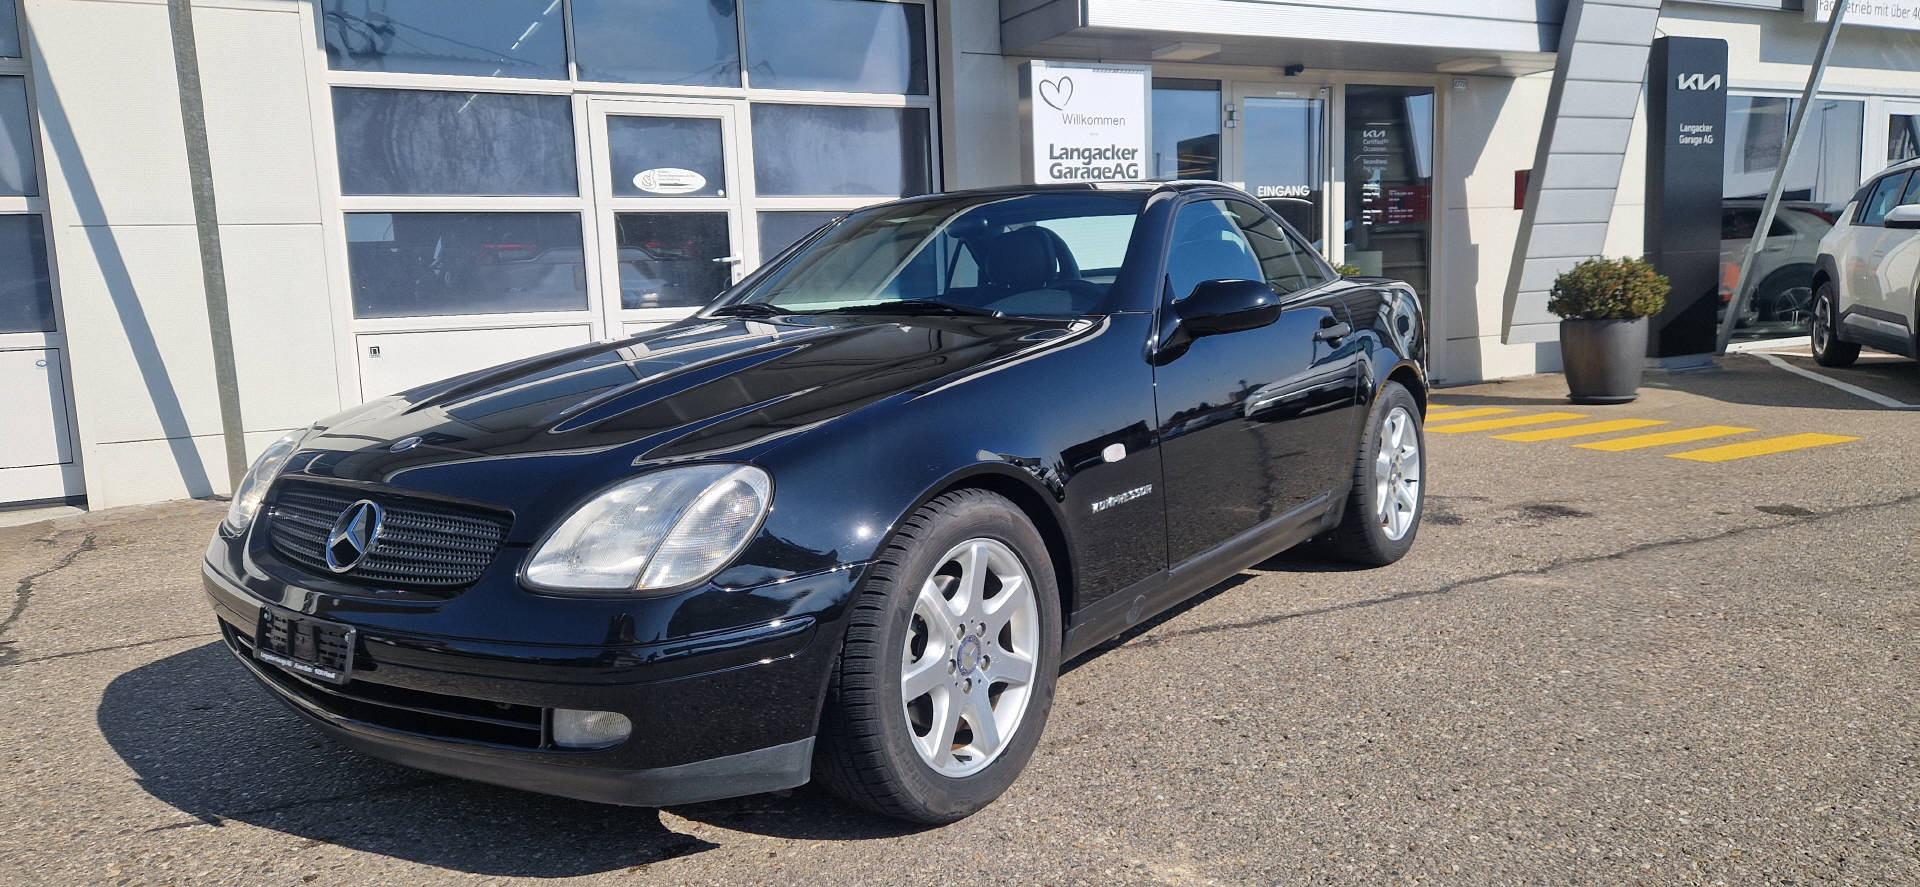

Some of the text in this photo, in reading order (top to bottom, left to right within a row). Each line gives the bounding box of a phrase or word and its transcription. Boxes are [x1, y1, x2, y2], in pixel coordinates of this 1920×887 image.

[1875, 4, 1889, 17] mit
[1891, 4, 1911, 19] über
[1678, 73, 1721, 91] KIA
[1062, 113, 1126, 126] Willkommen
[1680, 123, 1713, 135] Langacker
[1679, 134, 1714, 146] Garage AG
[1049, 143, 1138, 166] Langacker
[1257, 185, 1311, 198] EINGANG
